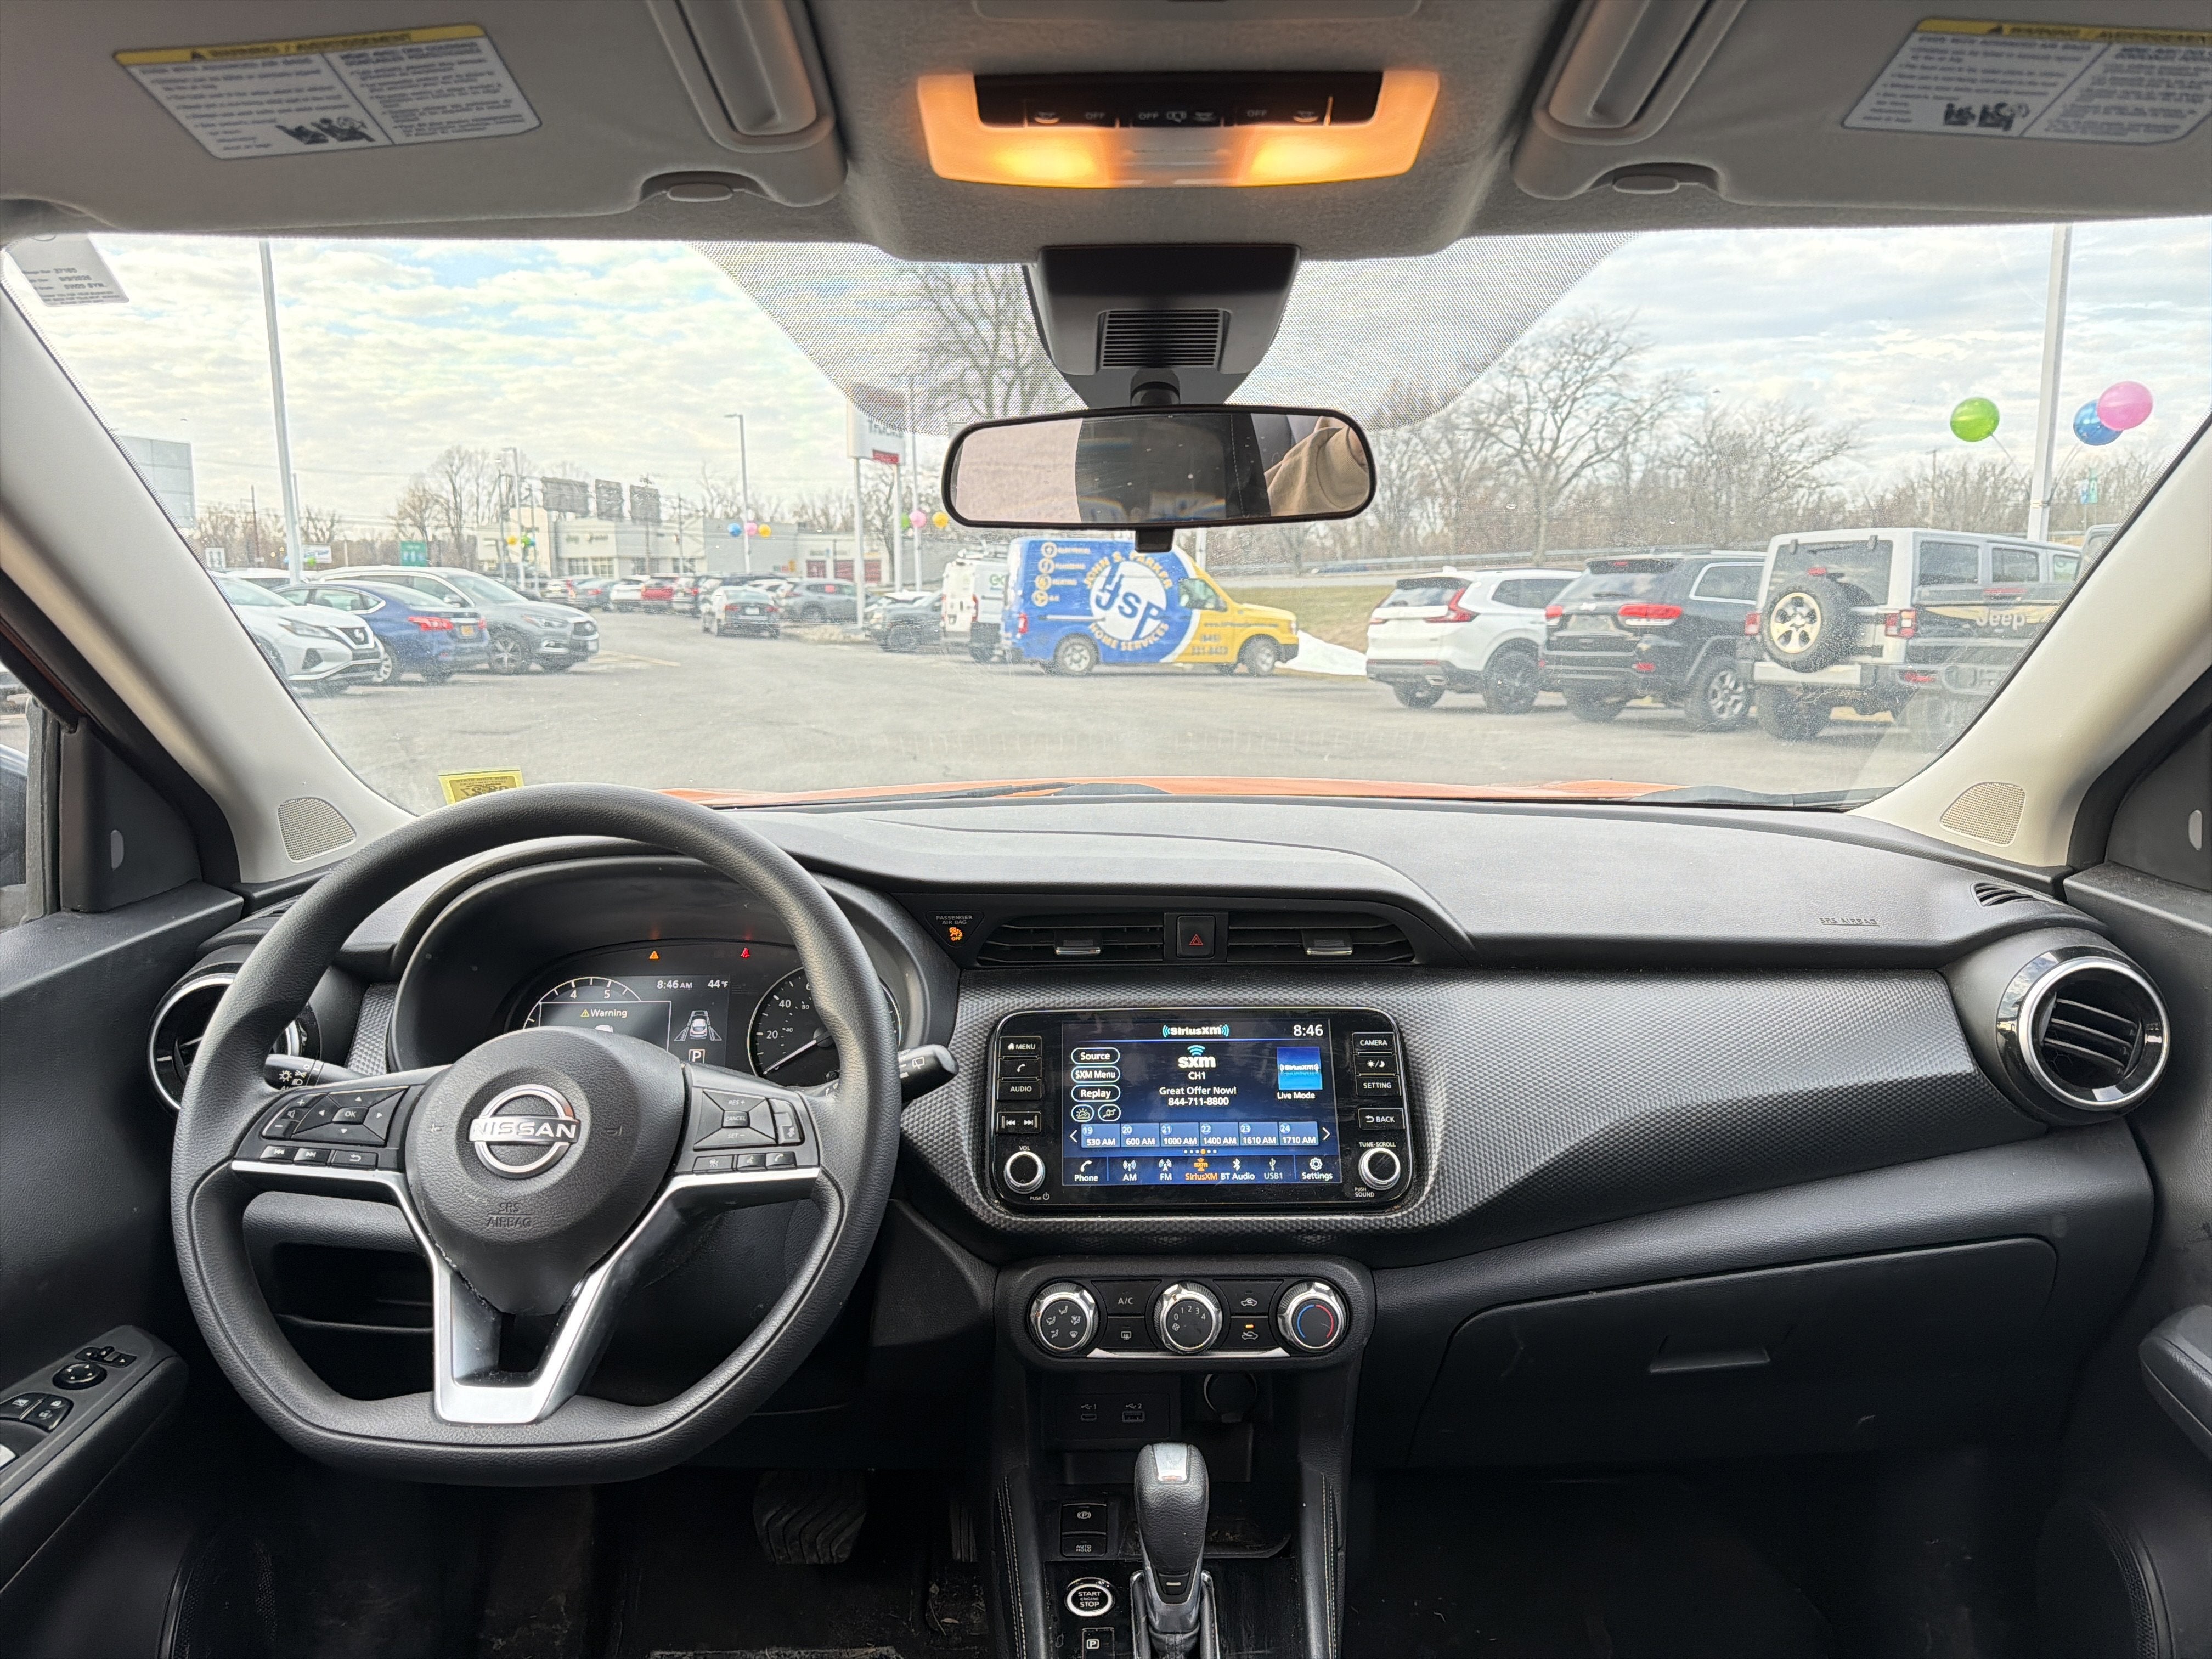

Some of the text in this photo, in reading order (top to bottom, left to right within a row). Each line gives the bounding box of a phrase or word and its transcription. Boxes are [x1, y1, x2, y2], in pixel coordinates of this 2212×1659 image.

[1976, 607, 2025, 630] Jeep
[1088, 623, 1169, 651] HOME SERVICES
[657, 980, 679, 989] 8:46
[570, 990, 577, 999] 4
[604, 990, 611, 999] 5
[778, 1000, 791, 1008] 40
[590, 1009, 628, 1018] Warning
[766, 1030, 778, 1039] 20
[1293, 1024, 1324, 1036] 8:46
[692, 1051, 701, 1062] P
[1080, 1052, 1111, 1060] Source
[1075, 1070, 1116, 1079] SXM Menu
[1188, 1071, 1206, 1080] CH1
[1080, 1089, 1111, 1099] Replay
[1187, 1086, 1210, 1094] Offer
[1213, 1086, 1237, 1094] Now!
[1168, 1097, 1229, 1106] 844-711-8800
[472, 1122, 577, 1138] NISSAN
[1121, 1126, 1132, 1134] 20
[1161, 1125, 1171, 1133] 21
[1086, 1138, 1101, 1146] 530
[1302, 1172, 1333, 1181] Settings
[499, 1202, 520, 1213] SRS
[487, 1216, 532, 1228] AIRBAG
